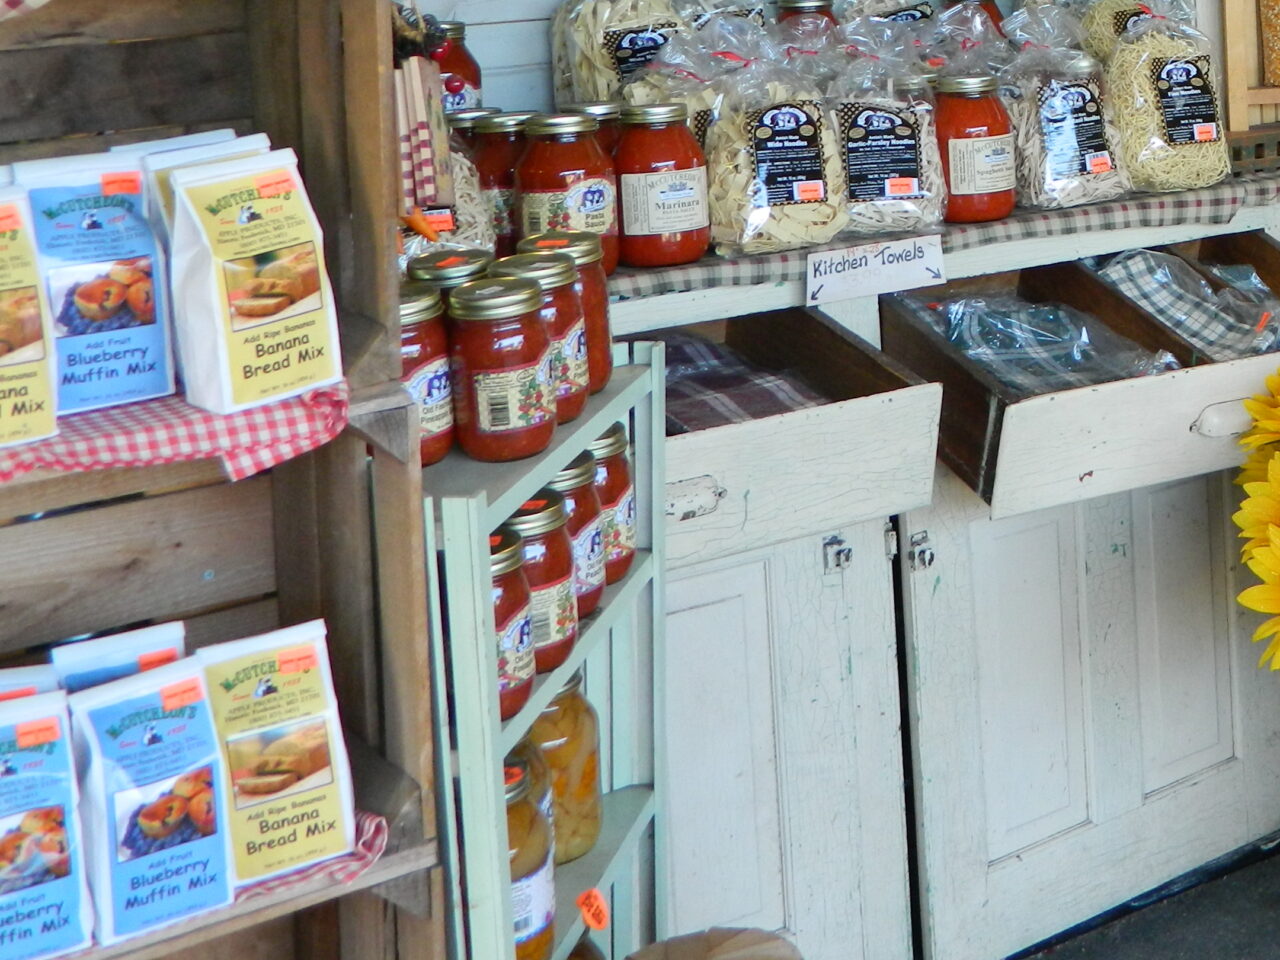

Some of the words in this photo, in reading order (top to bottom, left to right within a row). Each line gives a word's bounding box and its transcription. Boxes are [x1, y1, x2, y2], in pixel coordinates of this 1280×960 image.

[655, 198, 701, 211] Marinara
[585, 212, 605, 221] Pasta
[585, 220, 606, 228] Sauce
[813, 254, 868, 279] Kitchen
[874, 241, 925, 265] Towels
[284, 320, 316, 334] Bananas
[255, 334, 310, 358] Banana
[66, 347, 150, 368] Blueberry
[242, 354, 291, 380] Bread
[298, 346, 325, 364] Mix
[62, 366, 120, 386] Muffin
[127, 361, 158, 376] Mix
[11, 399, 46, 417] Mix
[291, 795, 327, 810] Bananas
[259, 809, 320, 834] Banana
[246, 829, 297, 856] Bread
[306, 820, 337, 838] Mix
[131, 859, 211, 891] Blueberry
[125, 884, 181, 911] Muffin
[188, 873, 218, 891] Mix
[41, 914, 70, 934] Mix
